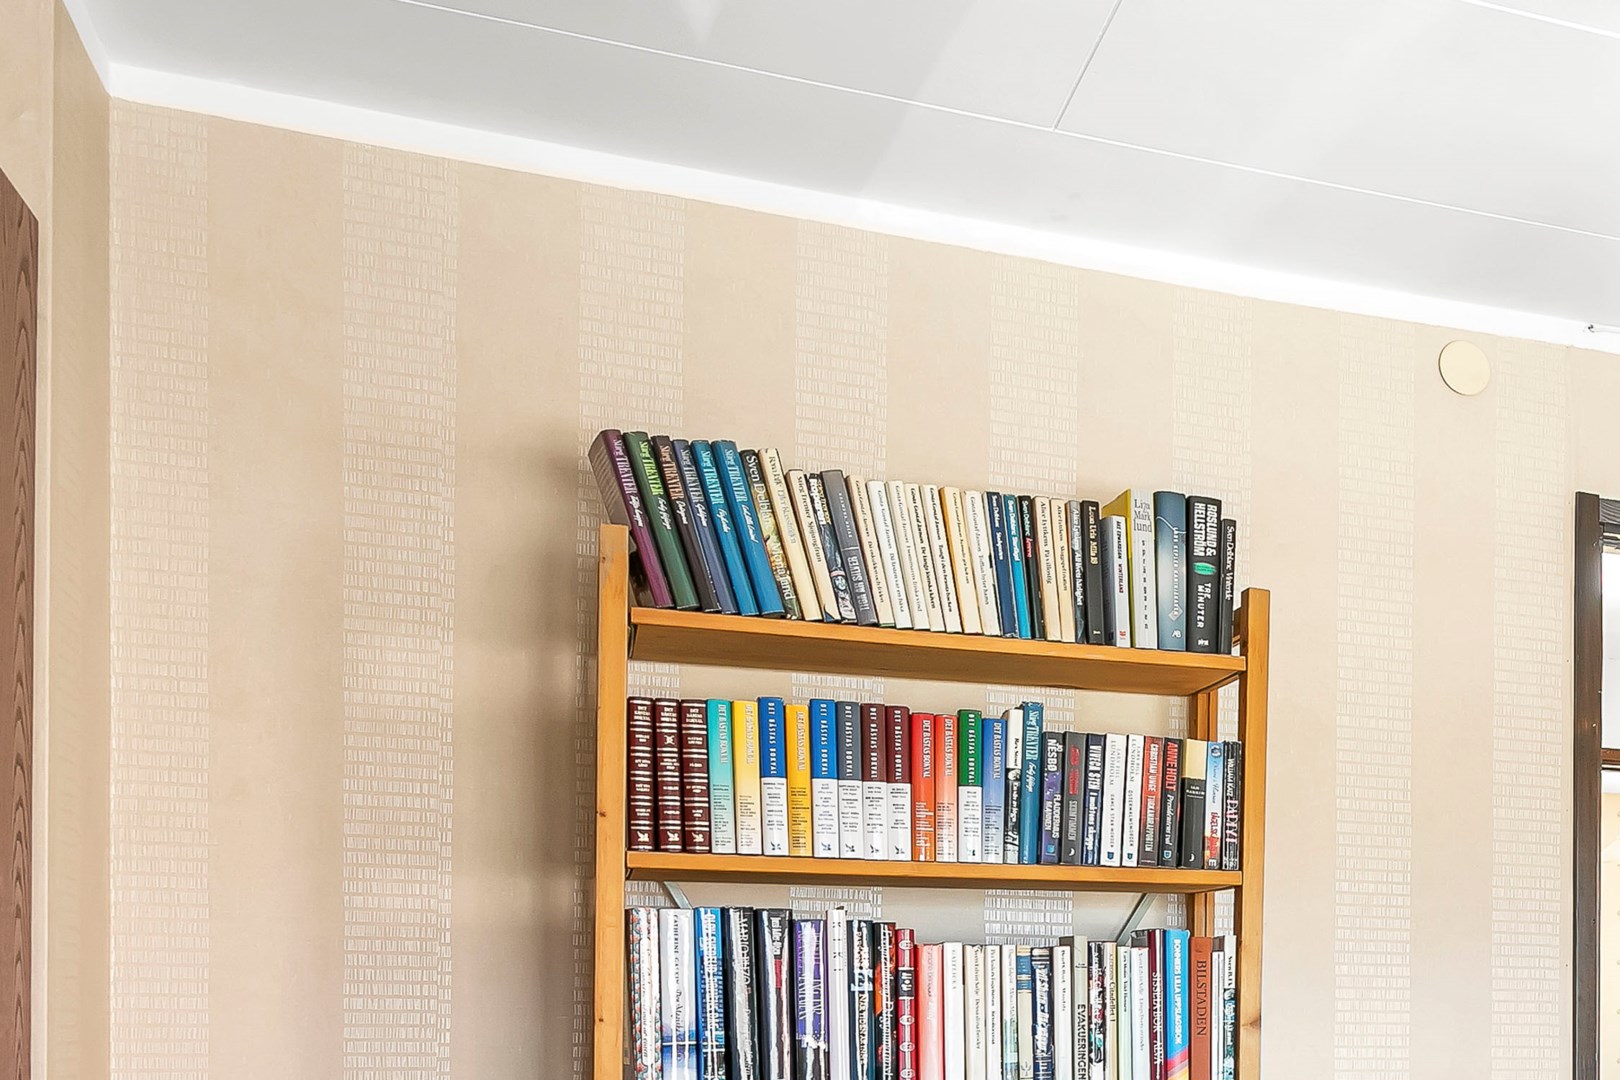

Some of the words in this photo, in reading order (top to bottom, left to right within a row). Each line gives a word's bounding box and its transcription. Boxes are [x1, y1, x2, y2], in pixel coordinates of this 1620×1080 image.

[617, 456, 638, 494] TRENTER
[644, 457, 664, 495] TRENTER
[662, 461, 685, 499] TRENTER
[684, 465, 704, 503] TRENTER
[730, 466, 748, 502] TRENTER
[746, 455, 759, 481] Sven
[704, 467, 724, 504] TRENTER
[1089, 506, 1097, 524] Leon
[1193, 503, 1206, 557] HELLSTRÖM
[1206, 504, 1217, 547] ROSLUND
[1089, 525, 1097, 539] Uris
[1226, 526, 1234, 541] Sven
[1207, 547, 1216, 557] &
[1196, 585, 1204, 628] MINUTER
[1203, 583, 1211, 599] TRE
[1026, 727, 1039, 760] TRENTER
[1047, 739, 1057, 771] NESBØ
[1088, 745, 1101, 771] VIVECA
[1166, 742, 1178, 767] ANNE
[1087, 773, 1102, 790] STEN
[1166, 768, 1177, 791] HOLT
[1196, 960, 1207, 1036] BILSTADEN
[1077, 1004, 1086, 1080] EVAKUERINGEN
